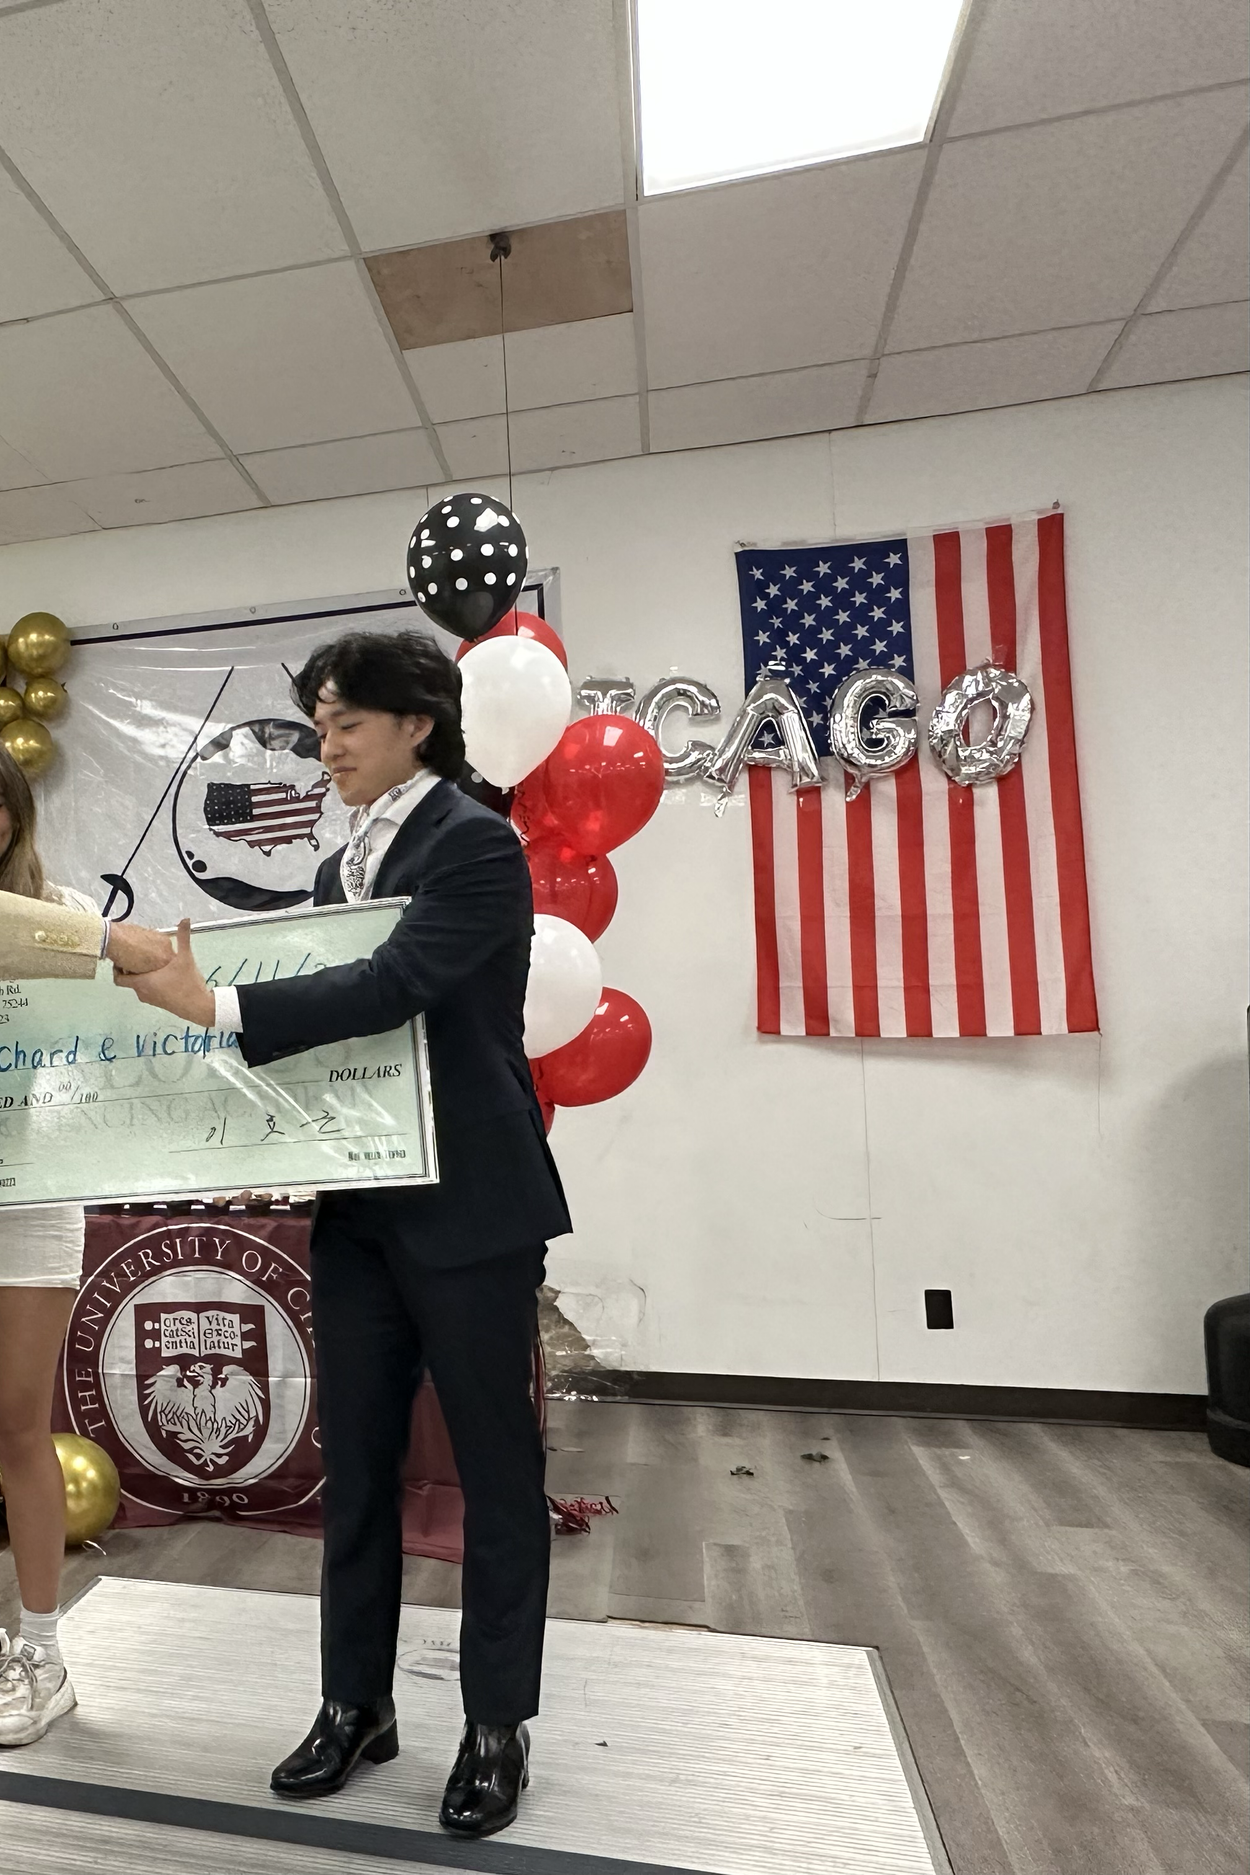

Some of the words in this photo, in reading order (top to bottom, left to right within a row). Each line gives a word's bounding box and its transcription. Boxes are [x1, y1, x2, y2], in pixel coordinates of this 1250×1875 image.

[577, 665, 1033, 793] CAGO
[328, 1063, 403, 1083] DOLLARS
[75, 1236, 231, 1353] UNIVERSITY
[241, 1249, 283, 1283] OF
[75, 1367, 108, 1439] THE
